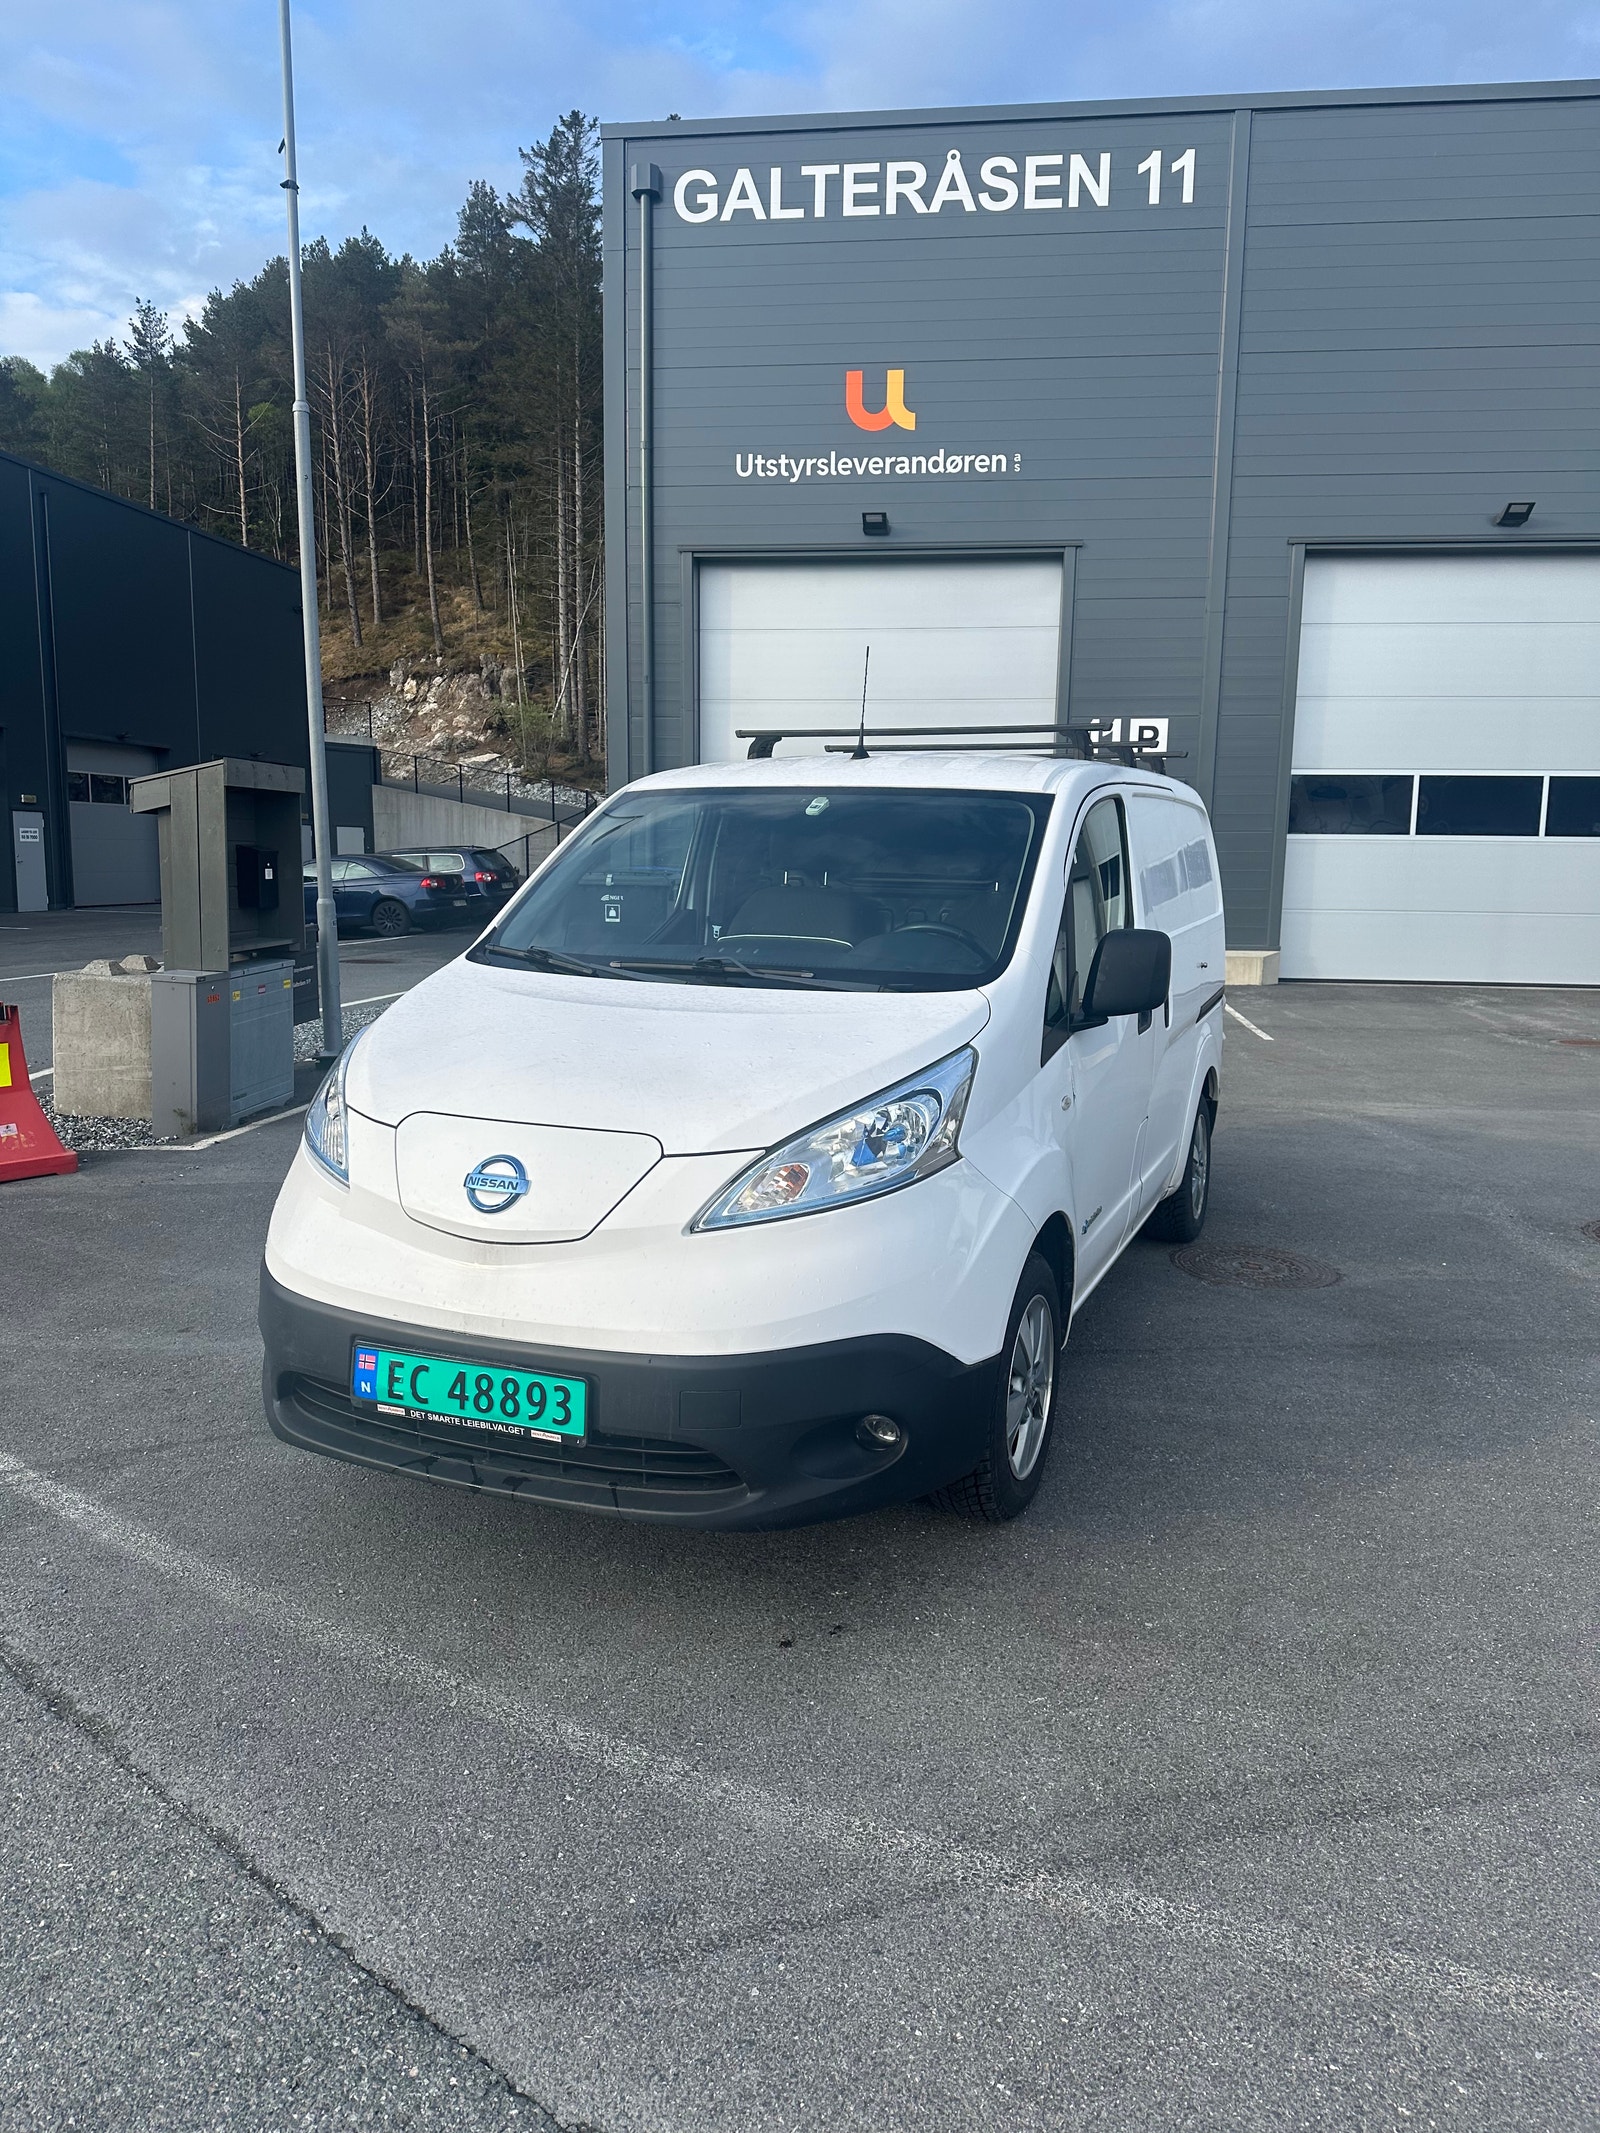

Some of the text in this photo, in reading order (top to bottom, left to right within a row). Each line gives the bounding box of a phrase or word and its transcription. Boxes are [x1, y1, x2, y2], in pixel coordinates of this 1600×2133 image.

[673, 148, 1196, 224] GALTERÅSEN 11
[735, 448, 1007, 483] Utstyrsleverandøren
[468, 1176, 519, 1190] NISSAN
[360, 1381, 371, 1393] N
[387, 1360, 572, 1426] EC 48893
[410, 1410, 426, 1419] DET
[427, 1413, 461, 1426] SMARTE
[461, 1418, 525, 1436] LEIEBILVALGET
